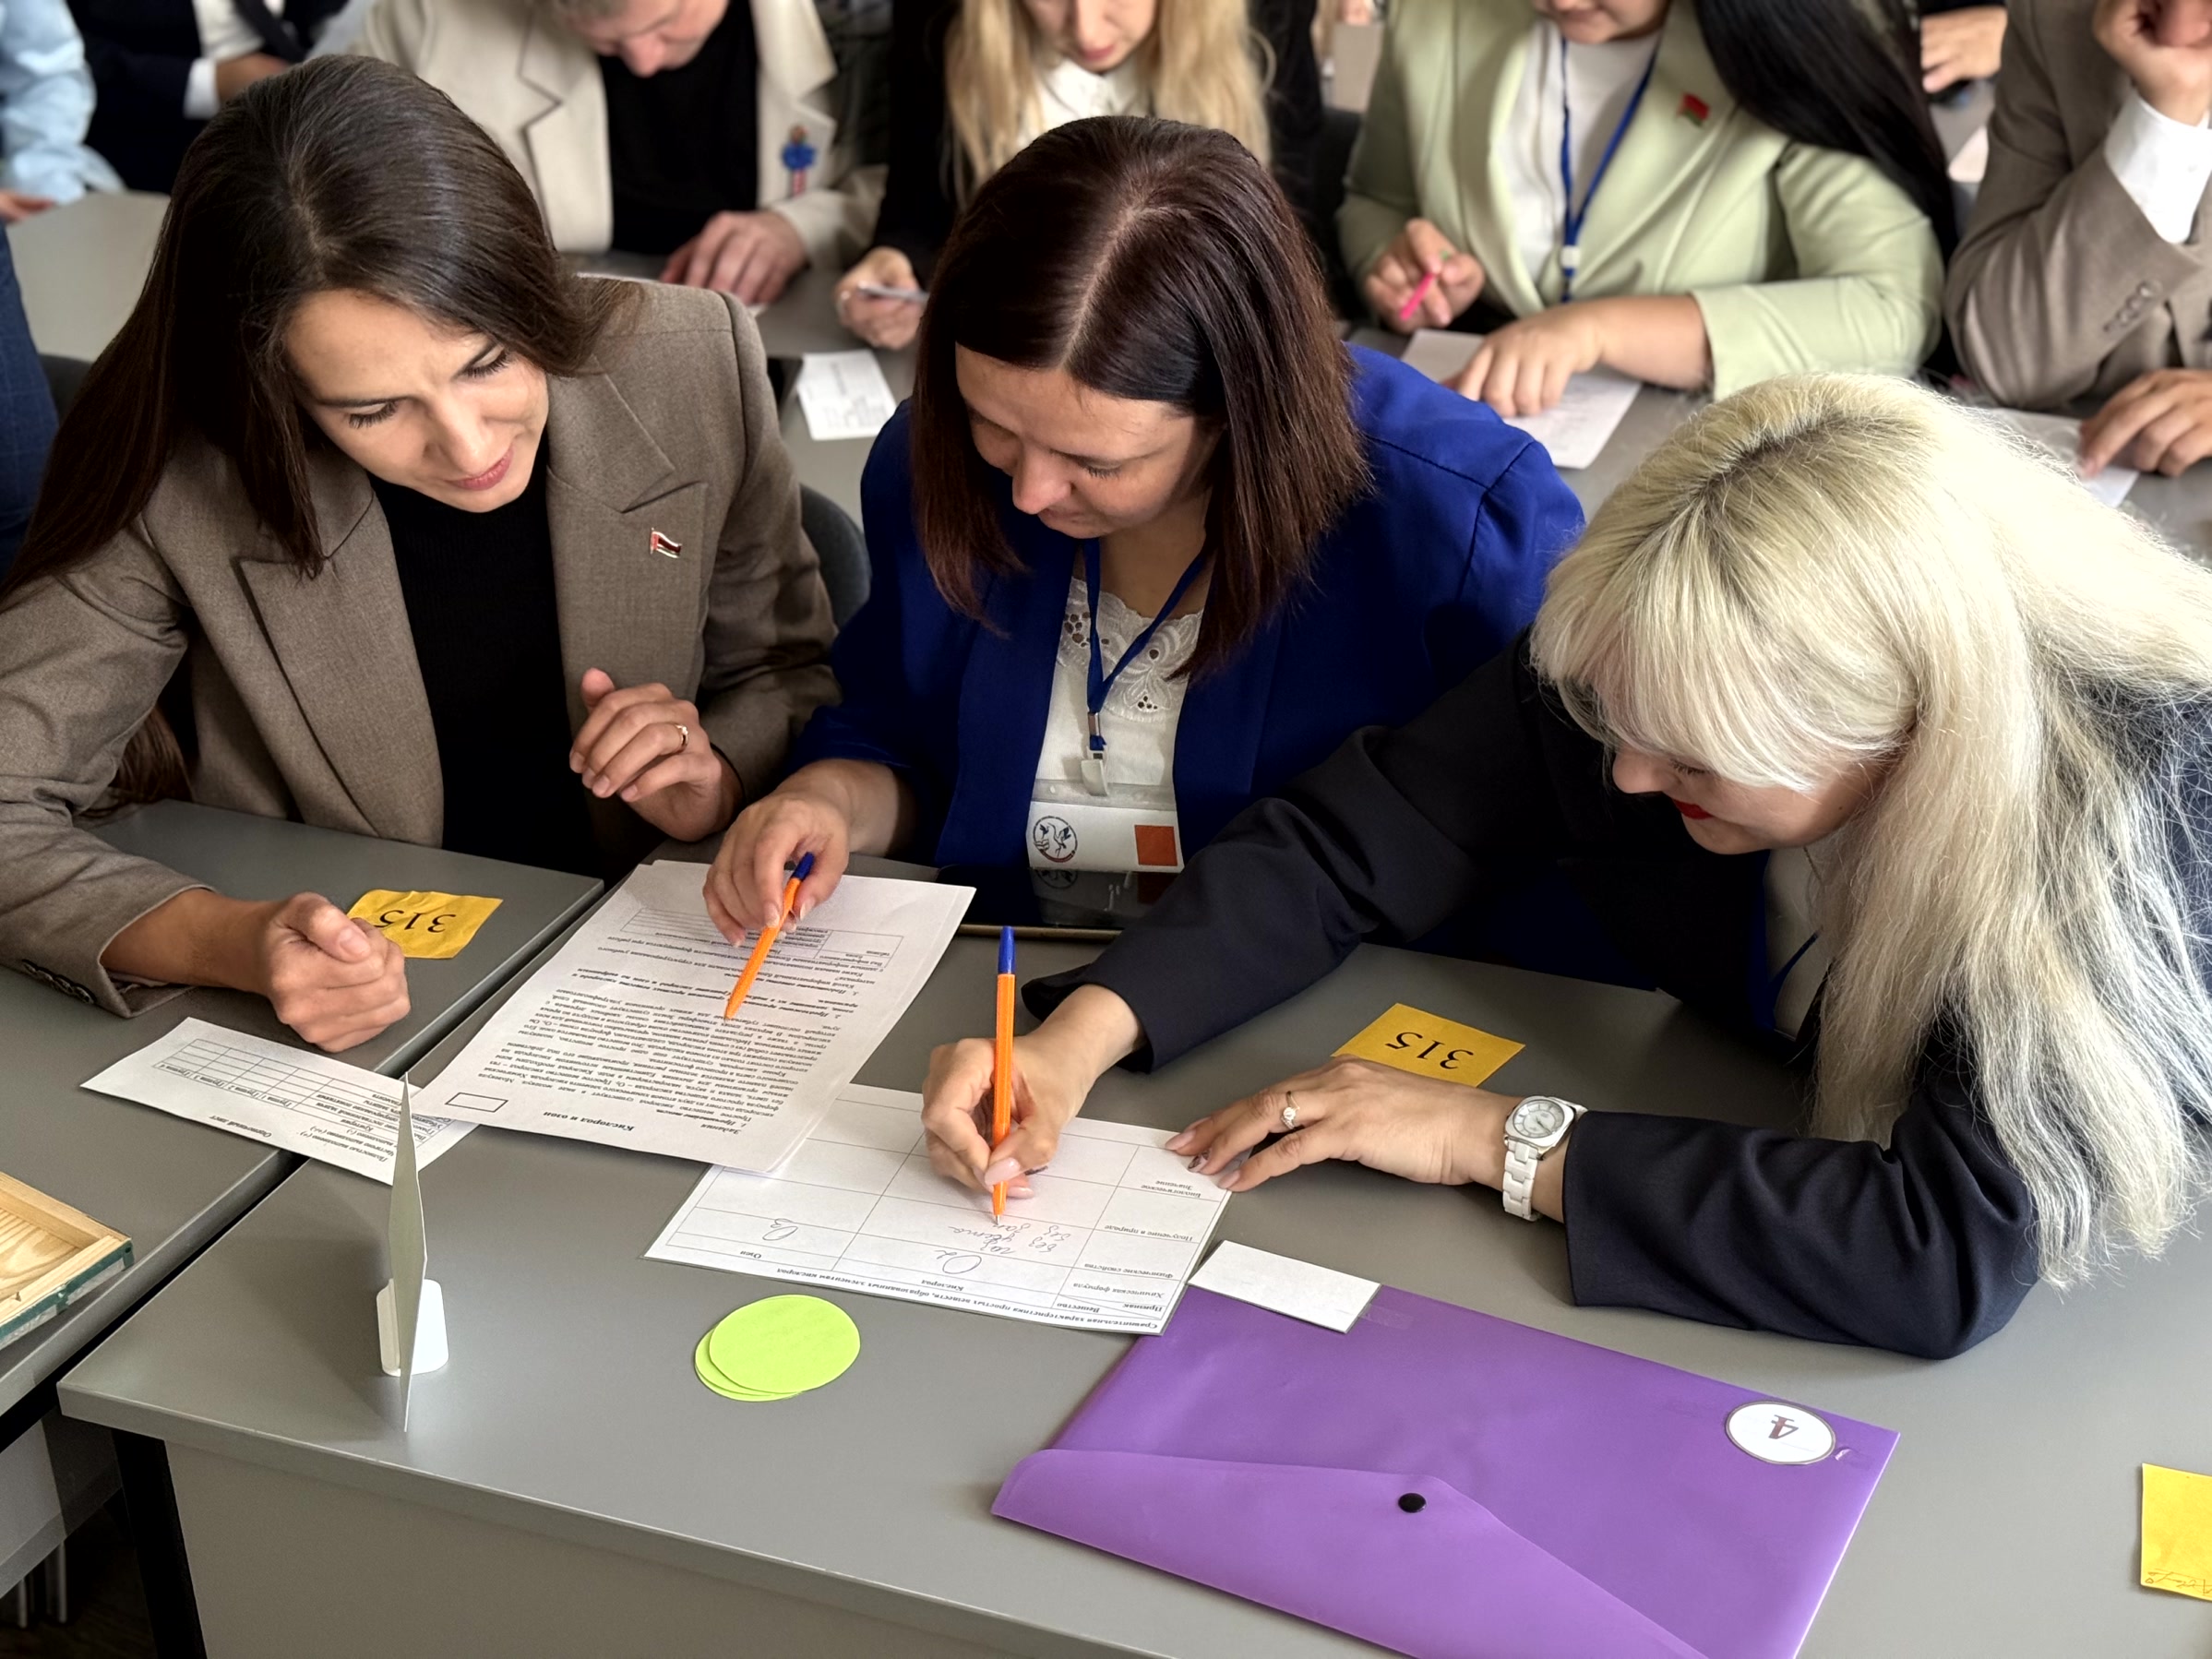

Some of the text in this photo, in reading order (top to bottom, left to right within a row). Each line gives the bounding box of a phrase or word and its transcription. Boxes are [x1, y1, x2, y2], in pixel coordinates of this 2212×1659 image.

[374, 910, 457, 934] 315
[1385, 1032, 1475, 1070] 315
[483, 1067, 529, 1078] Химическая
[508, 1064, 544, 1072] кислород
[556, 1064, 593, 1074] Кислород
[476, 1073, 515, 1082] Молекула
[580, 1076, 612, 1084] Простое
[633, 1084, 673, 1093] кислорода
[591, 1092, 634, 1102] существует
[673, 1091, 709, 1099] вещества
[710, 1096, 745, 1104] простого
[638, 1099, 675, 1108] кислород
[745, 1102, 780, 1111] формула
[678, 1105, 714, 1114] вещество
[735, 1107, 774, 1116] кислорода
[719, 1112, 752, 1121] Простое
[225, 1121, 273, 1137] Оценочный
[580, 1117, 635, 1131] Кислород
[699, 1124, 741, 1134] Задания
[310, 1135, 349, 1148] выполнено
[324, 1131, 364, 1144] выполнено
[354, 1132, 394, 1145] выполнено
[345, 1146, 389, 1162] Полностью
[360, 1142, 397, 1155] Частично
[1155, 1180, 1193, 1190] Значение
[1141, 1185, 1201, 1198] Биологическое
[1043, 1225, 1071, 1241] без
[1105, 1224, 1139, 1233] природе
[1148, 1232, 1192, 1241] Получение
[1028, 1236, 1057, 1252] без
[740, 1250, 761, 1259] Озон
[777, 1268, 818, 1279] кислород
[1084, 1264, 1173, 1279] Физические свойства
[867, 1283, 929, 1297] образованных
[921, 1279, 964, 1292] Кислород
[1073, 1283, 1165, 1299] Химическая формула
[931, 1293, 971, 1305] веществ,
[973, 1301, 1010, 1311] простых
[1057, 1303, 1100, 1313] Вещество
[1122, 1303, 1163, 1312] Признак
[1012, 1307, 1084, 1322] характеристика
[1087, 1319, 1157, 1330] Сравнительная
[1768, 1414, 1799, 1440] 4
